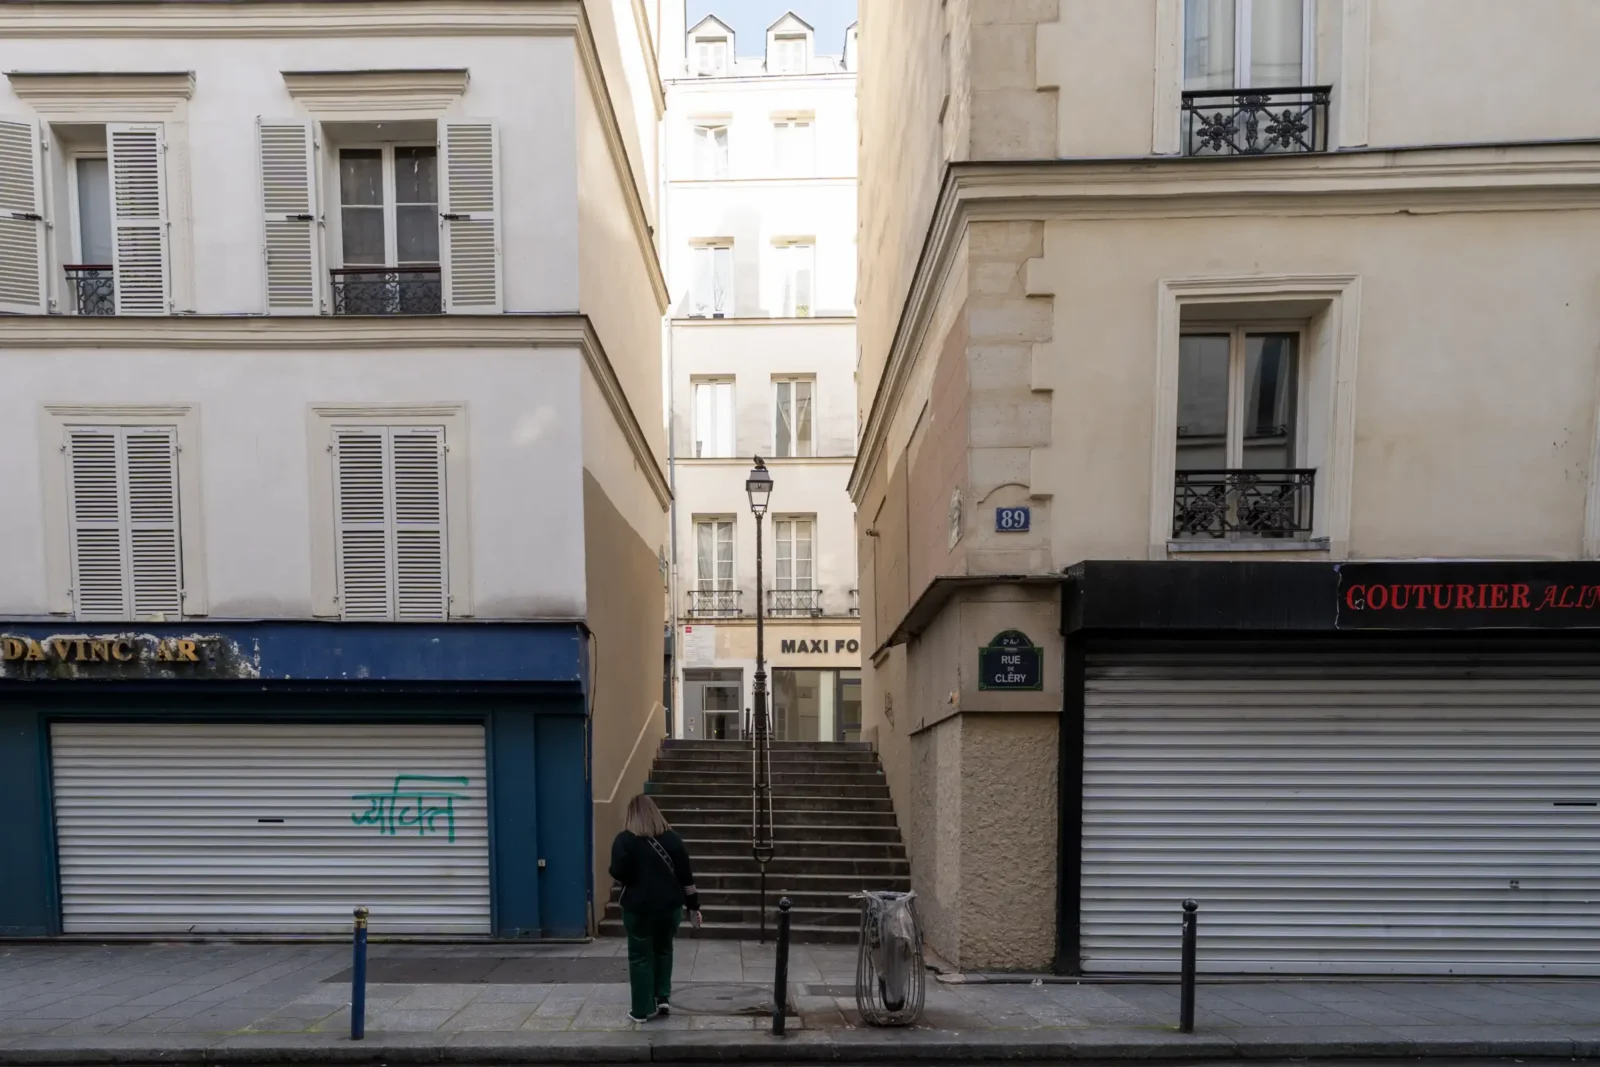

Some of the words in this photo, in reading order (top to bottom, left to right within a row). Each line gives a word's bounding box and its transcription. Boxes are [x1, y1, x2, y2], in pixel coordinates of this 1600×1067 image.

[1001, 510, 1025, 528] 89
[1346, 583, 1532, 610] COUTURIER
[3, 638, 47, 662] DA
[781, 639, 829, 653] MAXI
[1001, 655, 1021, 664] RUE
[995, 672, 1027, 683] CLÉRY
